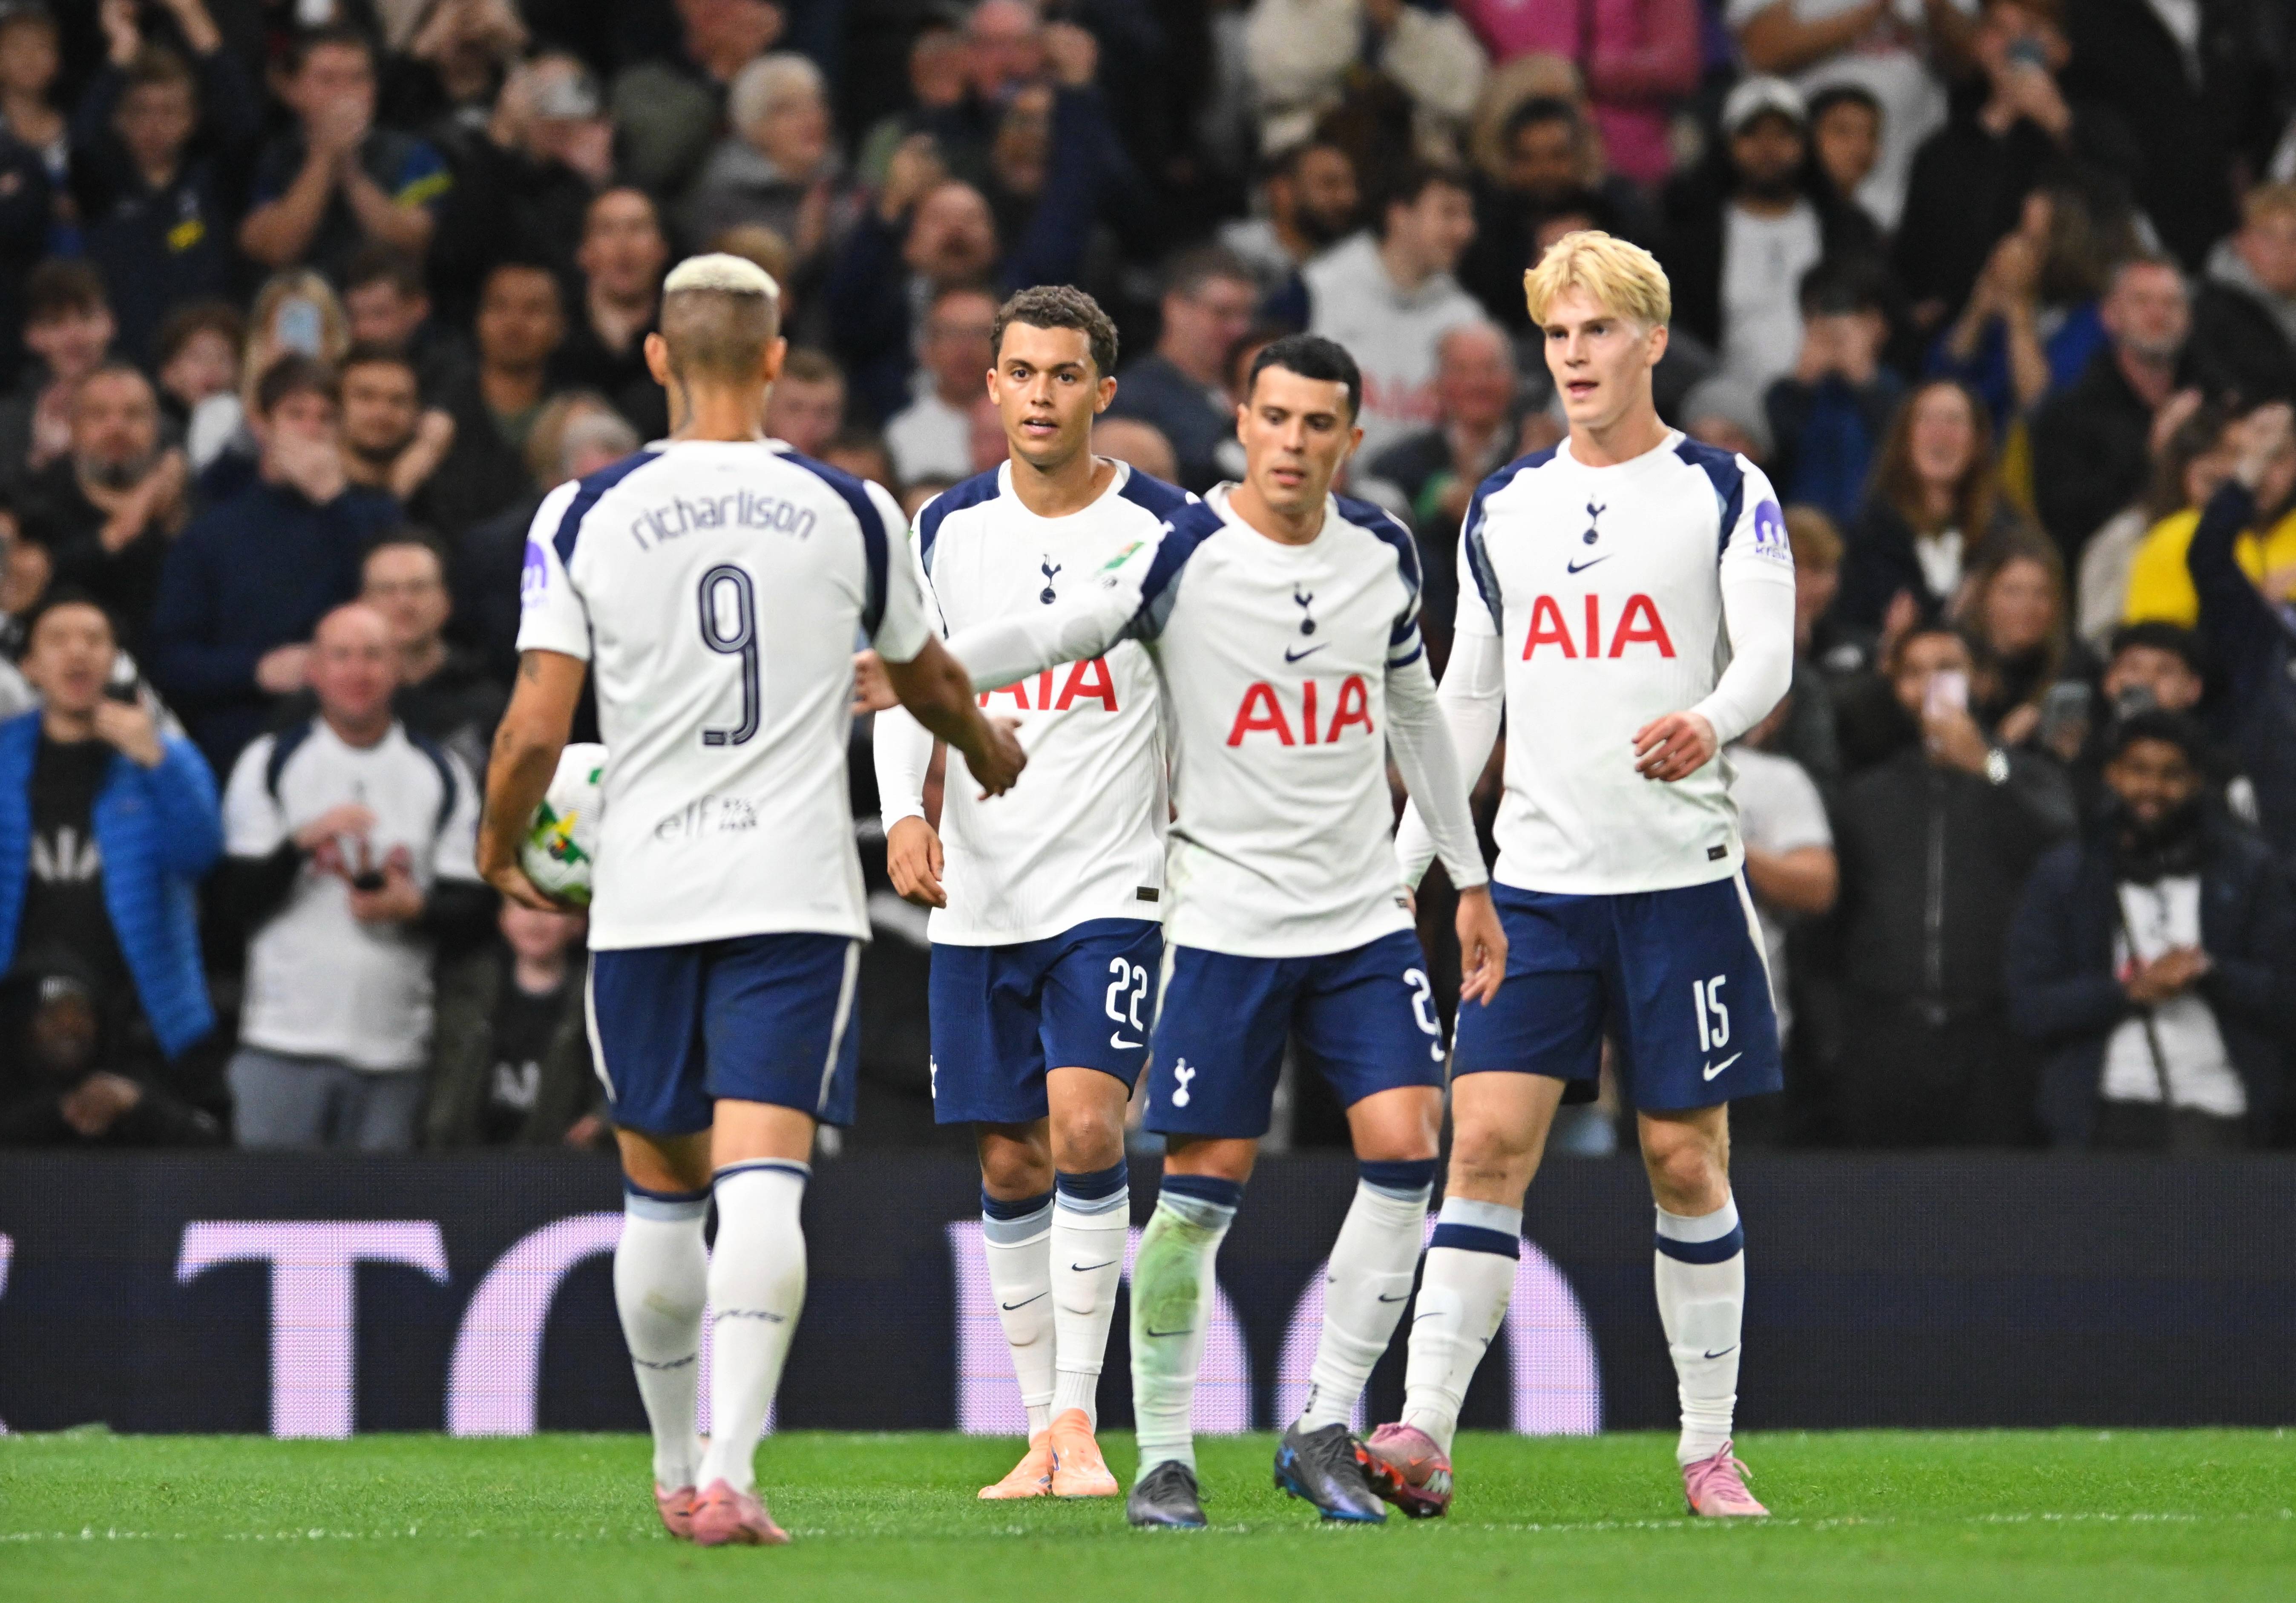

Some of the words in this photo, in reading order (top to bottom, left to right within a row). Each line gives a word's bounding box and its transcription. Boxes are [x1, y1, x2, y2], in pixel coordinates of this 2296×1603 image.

[631, 488, 817, 551] richarlison
[698, 564, 761, 747] 9
[1522, 593, 1676, 661] AIA
[1227, 673, 1374, 747] AIA
[1105, 957, 1148, 1032] 22
[1693, 974, 1729, 1052] 15
